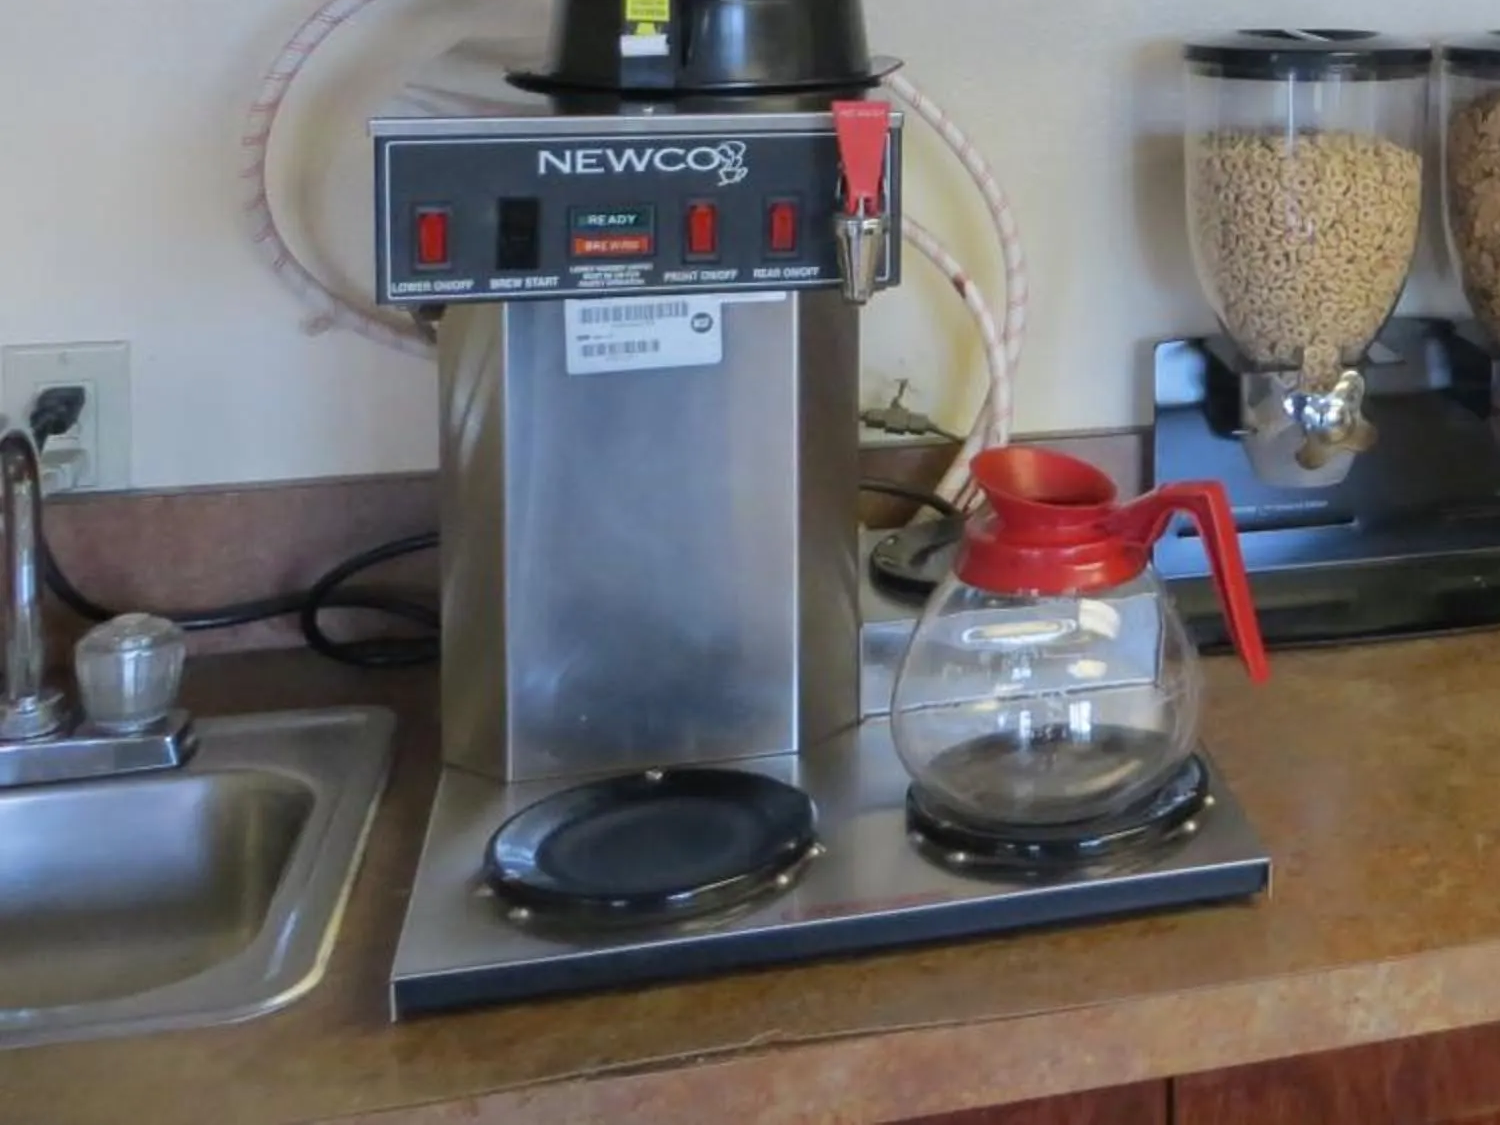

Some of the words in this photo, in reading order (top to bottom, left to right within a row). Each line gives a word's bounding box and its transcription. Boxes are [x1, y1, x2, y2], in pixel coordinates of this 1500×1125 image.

[538, 146, 720, 174] NEWCO
[588, 214, 638, 225] READY
[525, 276, 560, 287] START
